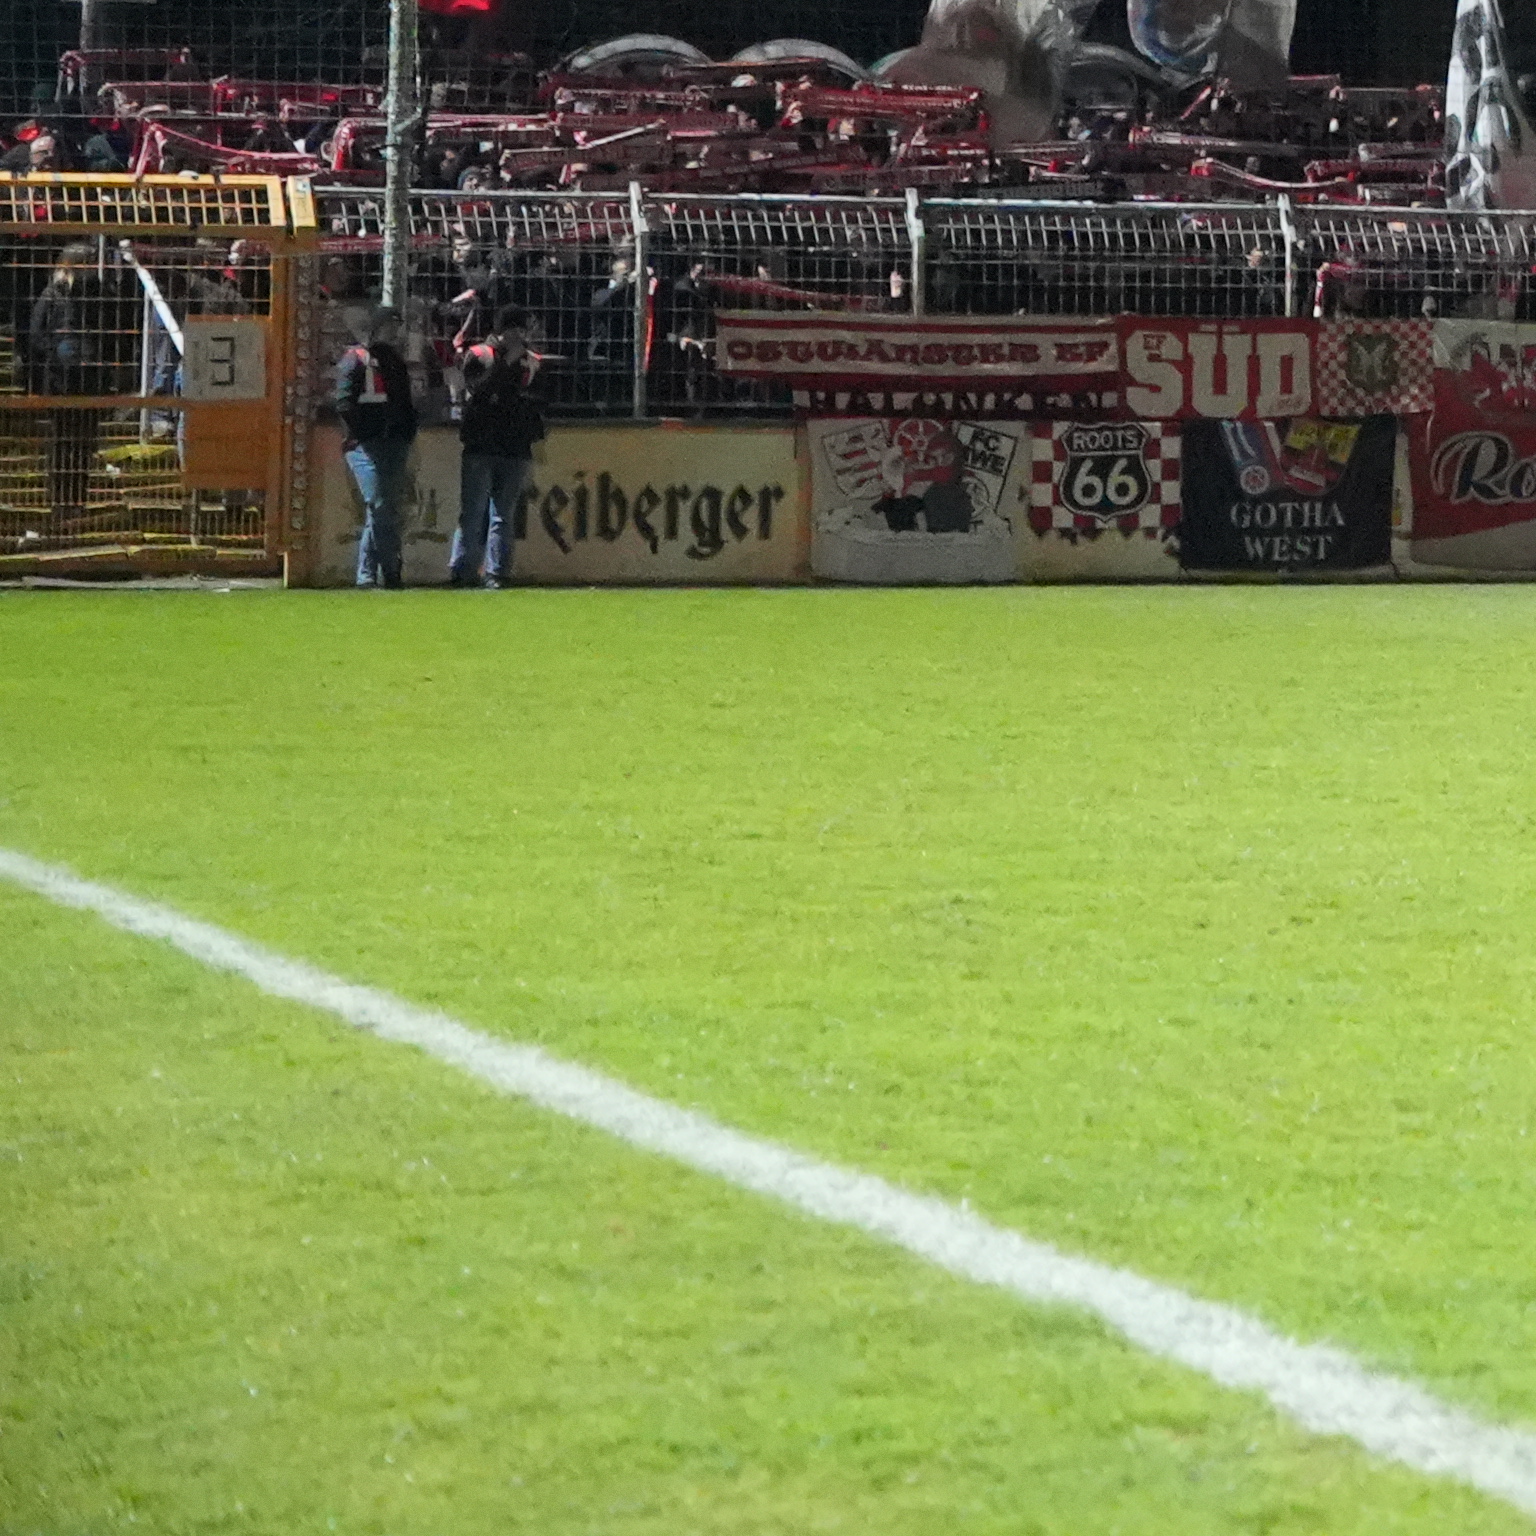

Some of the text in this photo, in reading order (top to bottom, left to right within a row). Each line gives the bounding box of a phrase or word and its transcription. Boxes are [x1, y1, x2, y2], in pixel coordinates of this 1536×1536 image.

[211, 336, 236, 387] 3
[1126, 324, 1312, 418] SÜD
[1072, 430, 1138, 451] ROOTS
[1072, 458, 1139, 507] 66
[513, 470, 784, 560] reiberger
[1230, 501, 1346, 528] GOTHA
[1244, 534, 1334, 562] WEST
